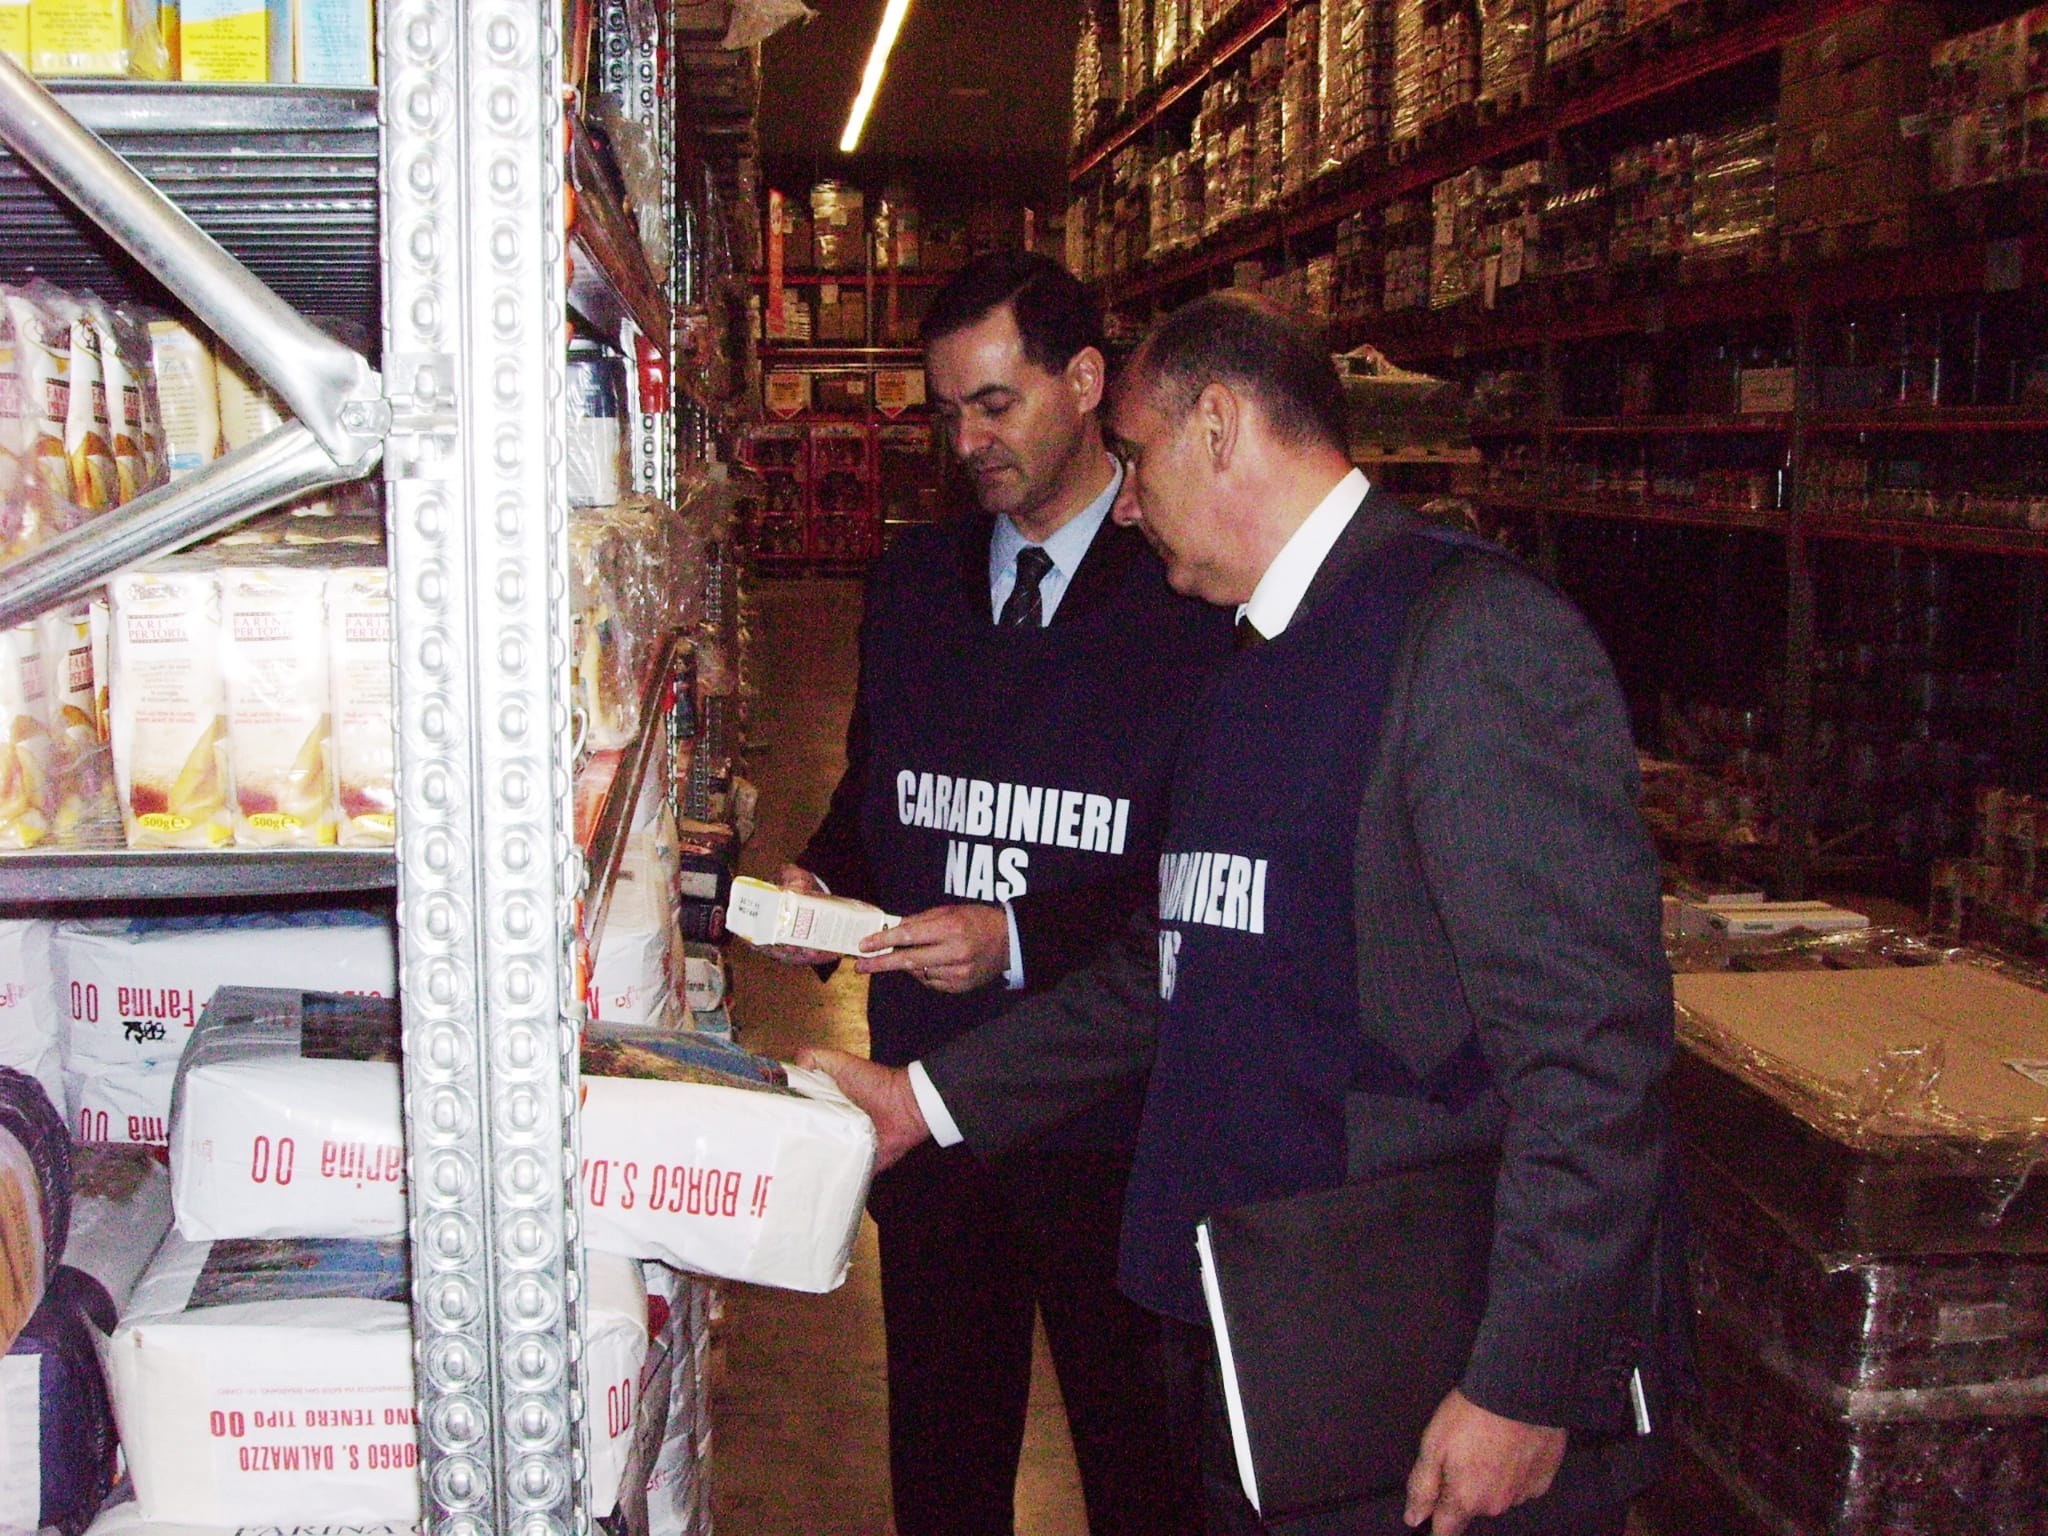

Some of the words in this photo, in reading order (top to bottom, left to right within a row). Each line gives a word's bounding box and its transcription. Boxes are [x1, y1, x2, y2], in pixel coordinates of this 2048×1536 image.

[897, 769, 1130, 855] CARABINIERI
[944, 839, 1029, 903] NAS
[71, 980, 99, 1024] 00
[116, 986, 196, 1028] Farina
[80, 1108, 108, 1142] 00
[128, 1115, 169, 1142] ina
[251, 1135, 295, 1186] 00
[321, 1140, 406, 1189] arina
[649, 1164, 742, 1218] BORGO
[209, 1409, 246, 1438] 00
[255, 1410, 295, 1427] TIPO
[306, 1410, 373, 1427] TENERO
[608, 1378, 631, 1438] 00
[239, 1444, 335, 1472] DALMAZZO
[338, 1443, 360, 1471] S.
[368, 1442, 425, 1470] ORGO
